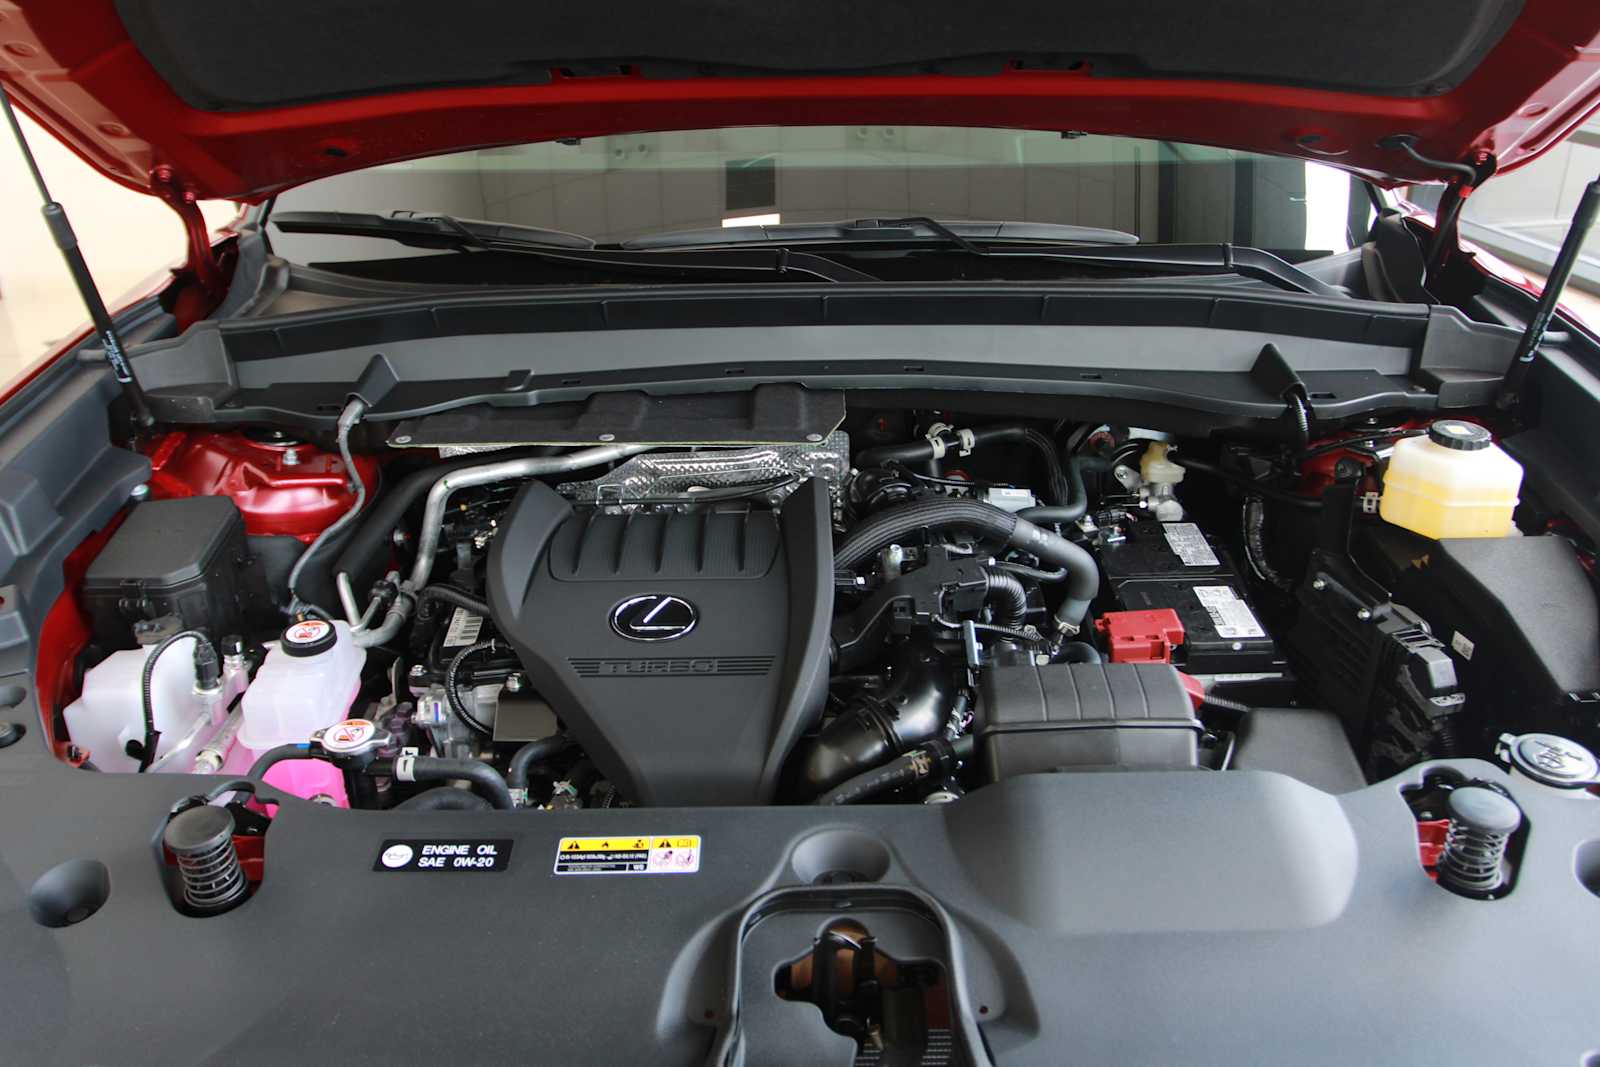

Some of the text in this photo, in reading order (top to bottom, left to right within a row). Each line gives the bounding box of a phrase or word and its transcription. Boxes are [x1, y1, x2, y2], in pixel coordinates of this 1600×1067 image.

[602, 660, 715, 673] TURBO
[422, 845, 498, 855] ENGINE OIL
[418, 857, 494, 867] SAE 0W-20
